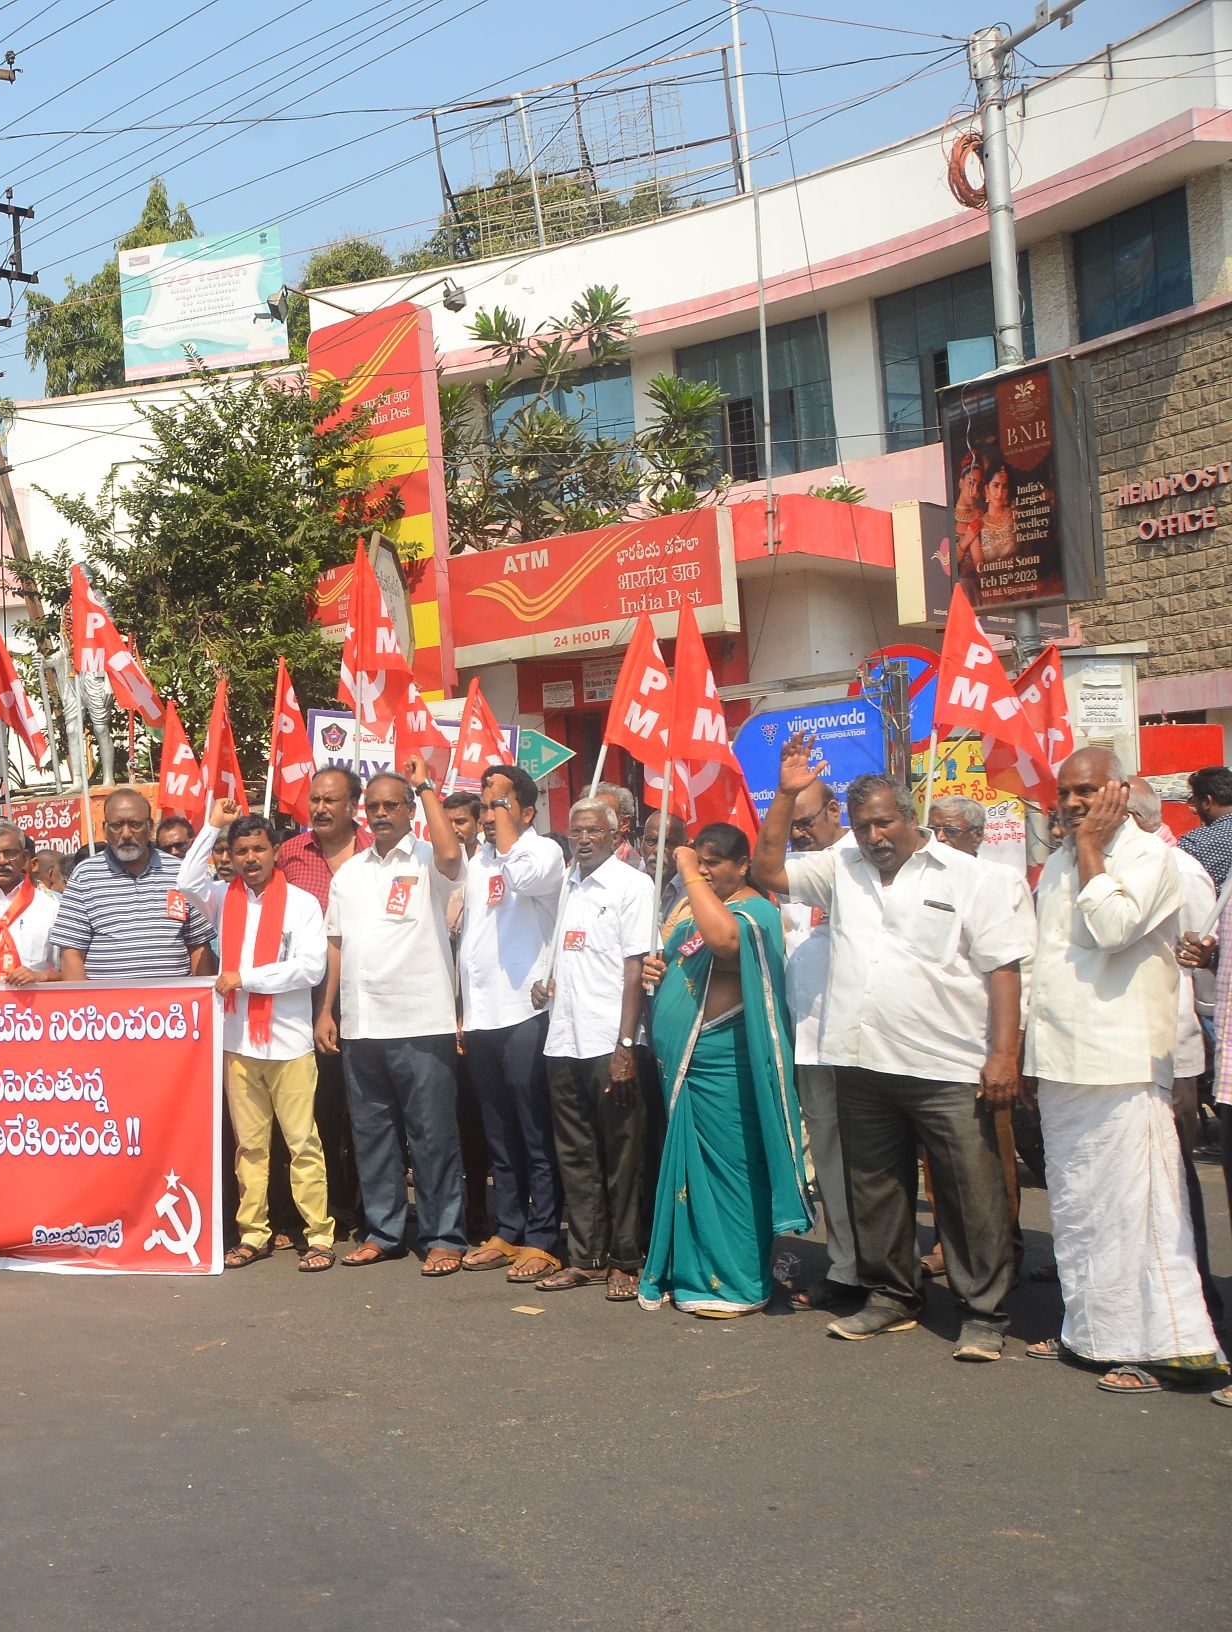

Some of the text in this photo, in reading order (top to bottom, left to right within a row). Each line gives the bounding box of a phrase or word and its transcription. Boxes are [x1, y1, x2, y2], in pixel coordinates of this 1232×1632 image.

[390, 406, 412, 420] Post
[1006, 419, 1047, 446] BNR
[1017, 481, 1044, 495] India's
[1118, 461, 1232, 506] HEAD POST
[1015, 493, 1046, 507] Largest
[1012, 505, 1050, 520] Premium
[1012, 517, 1050, 532] Jewellery
[1139, 505, 1218, 540] OFFICE
[1016, 529, 1048, 543] Retailer
[503, 548, 549, 575] ATM
[976, 554, 1040, 573] Coming Soon
[617, 560, 702, 592] भारतीय डाक
[980, 575, 997, 588] Feb
[1014, 569, 1038, 583] 2023
[1004, 583, 1037, 597] Vijayawada
[618, 594, 664, 615] India
[334, 626, 347, 634] HOU
[553, 628, 611, 648] 24 HOUR
[787, 707, 866, 733] vijayawada
[821, 730, 866, 742] CORPORATION
[328, 757, 391, 780] WAY
[388, 903, 404, 912] CPM
[32, 1219, 123, 1248] విజయవాడ
